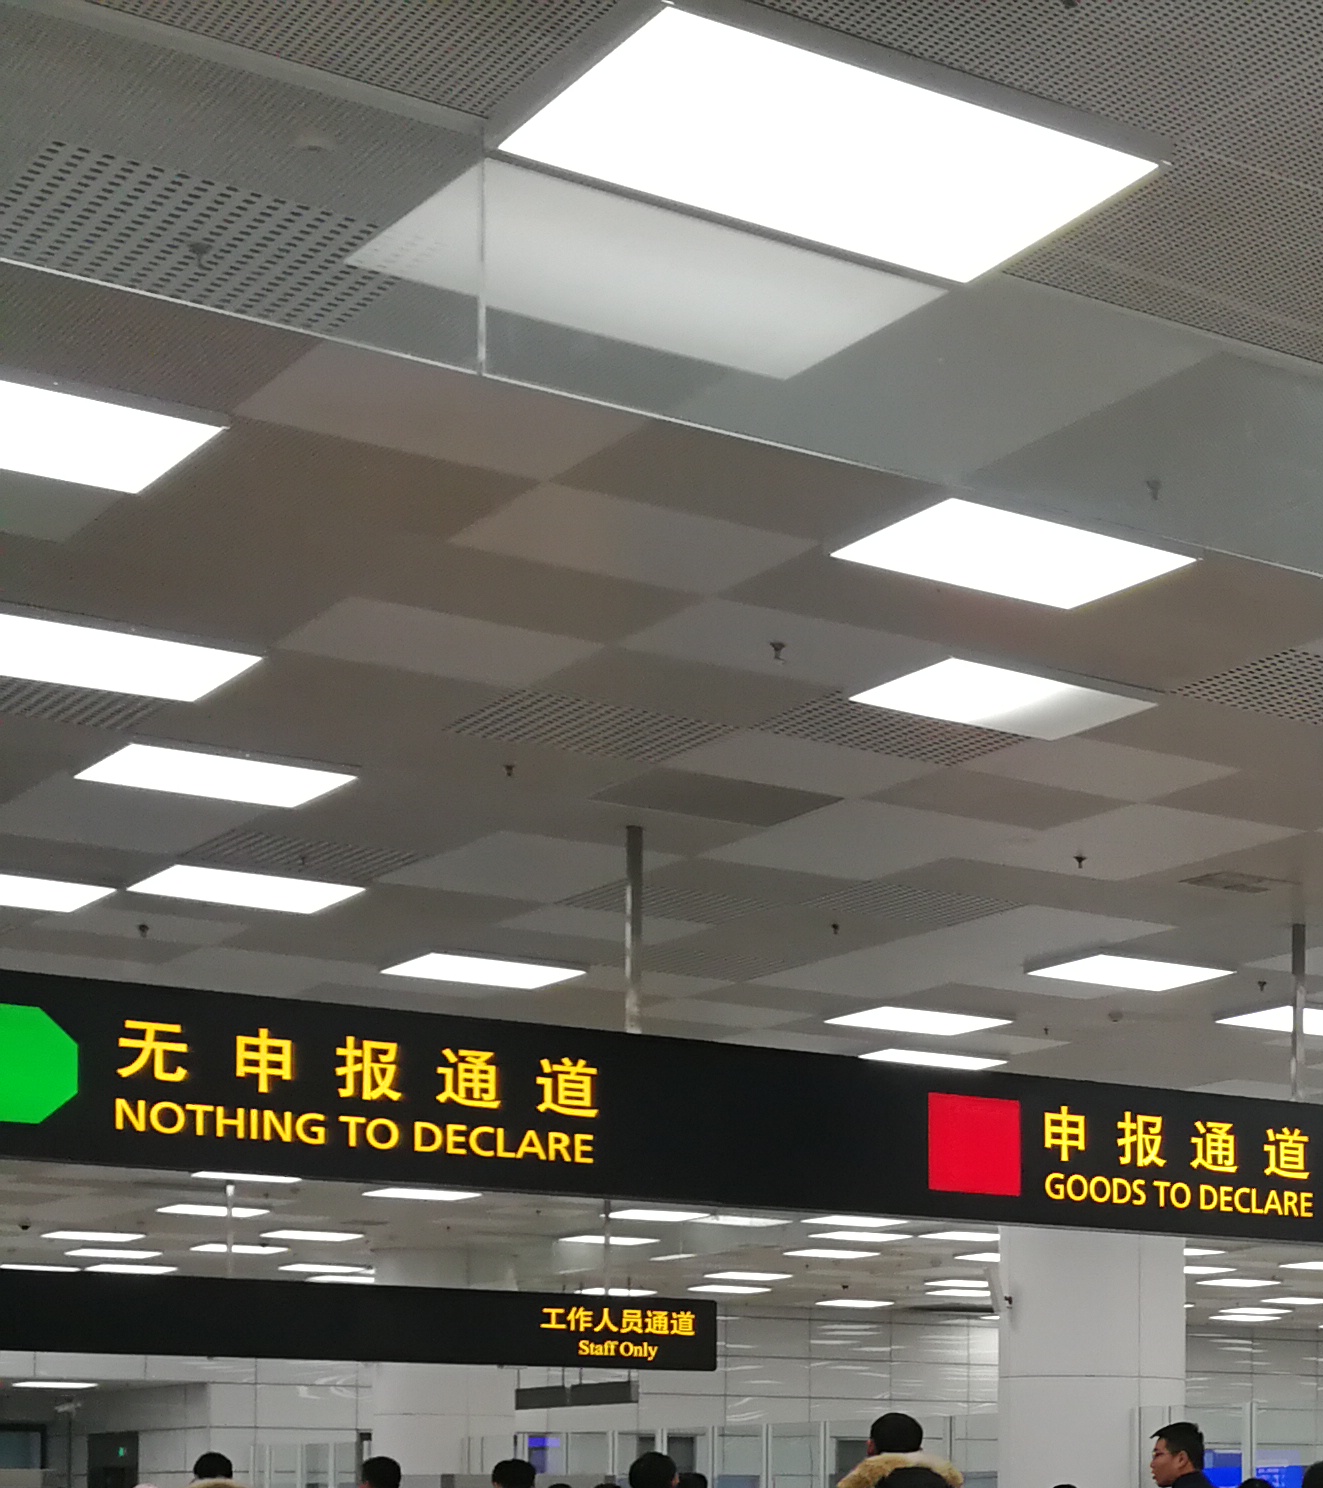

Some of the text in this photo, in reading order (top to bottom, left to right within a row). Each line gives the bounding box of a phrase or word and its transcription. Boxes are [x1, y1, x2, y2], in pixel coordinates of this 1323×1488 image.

[117, 1019, 600, 1118] 无申报通道
[114, 1097, 594, 1164] NOTHING TO DECLARE
[1043, 1105, 1311, 1181] 申报通道
[1044, 1172, 1314, 1218] GOODS TO DECLARE
[539, 1306, 696, 1337] 工作人员通道
[578, 1339, 659, 1361] Staff Only
